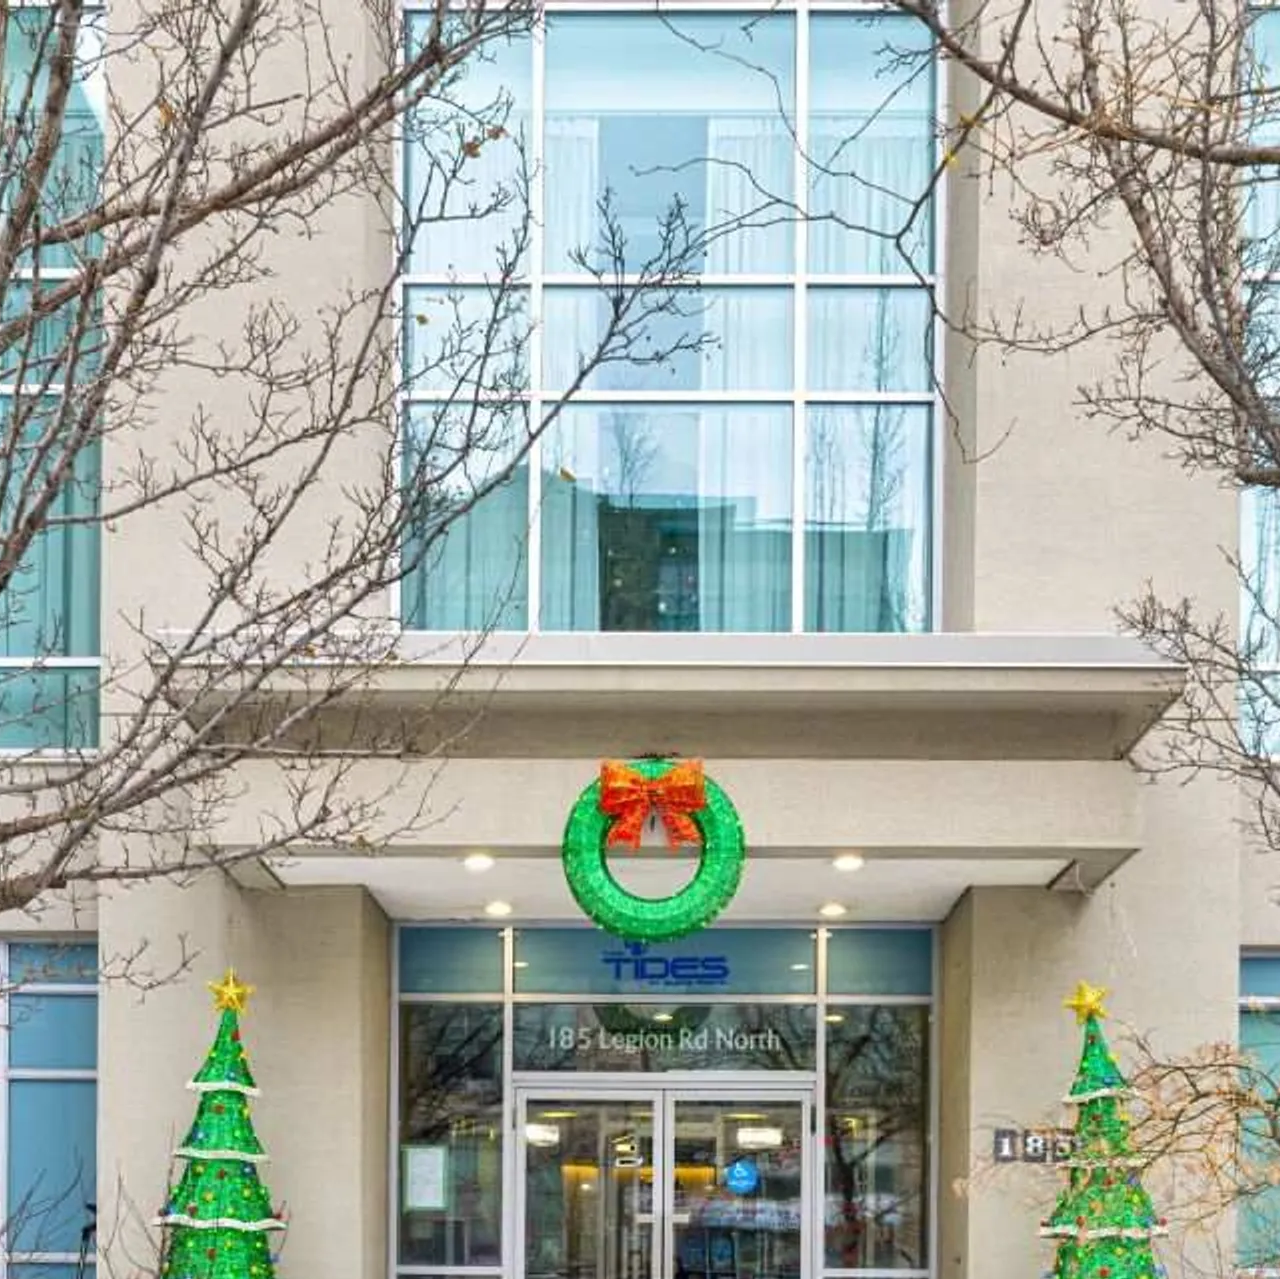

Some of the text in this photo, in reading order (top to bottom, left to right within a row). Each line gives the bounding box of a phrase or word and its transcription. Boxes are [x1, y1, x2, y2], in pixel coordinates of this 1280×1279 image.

[601, 956, 730, 980] TIDES
[548, 1026, 781, 1053] 185 Legion Rd North
